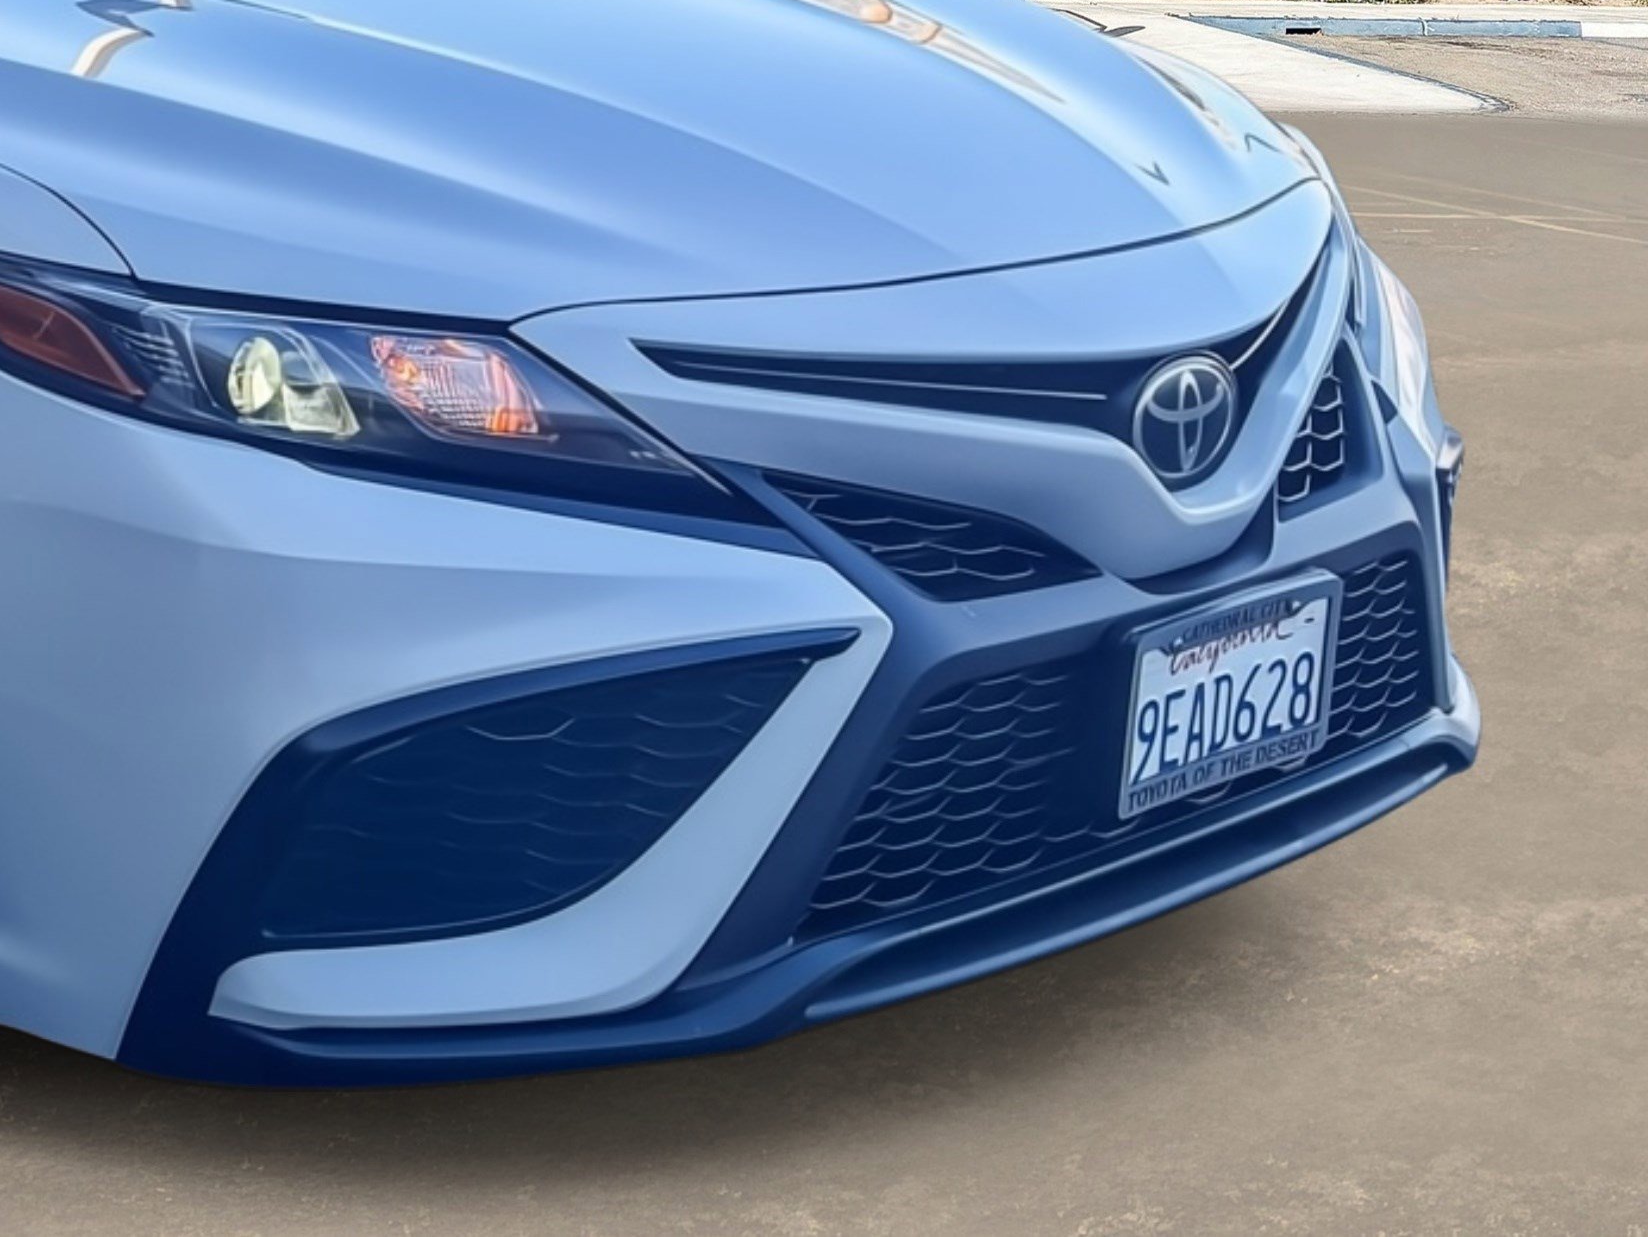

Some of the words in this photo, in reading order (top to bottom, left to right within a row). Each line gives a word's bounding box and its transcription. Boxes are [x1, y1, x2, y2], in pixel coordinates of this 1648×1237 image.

[1128, 770, 1187, 811] TOYOTA
[1192, 761, 1215, 786] OF
[1219, 751, 1250, 778] THE
[1256, 729, 1319, 761] DESERT
[1131, 652, 1315, 786] 9EAD628
